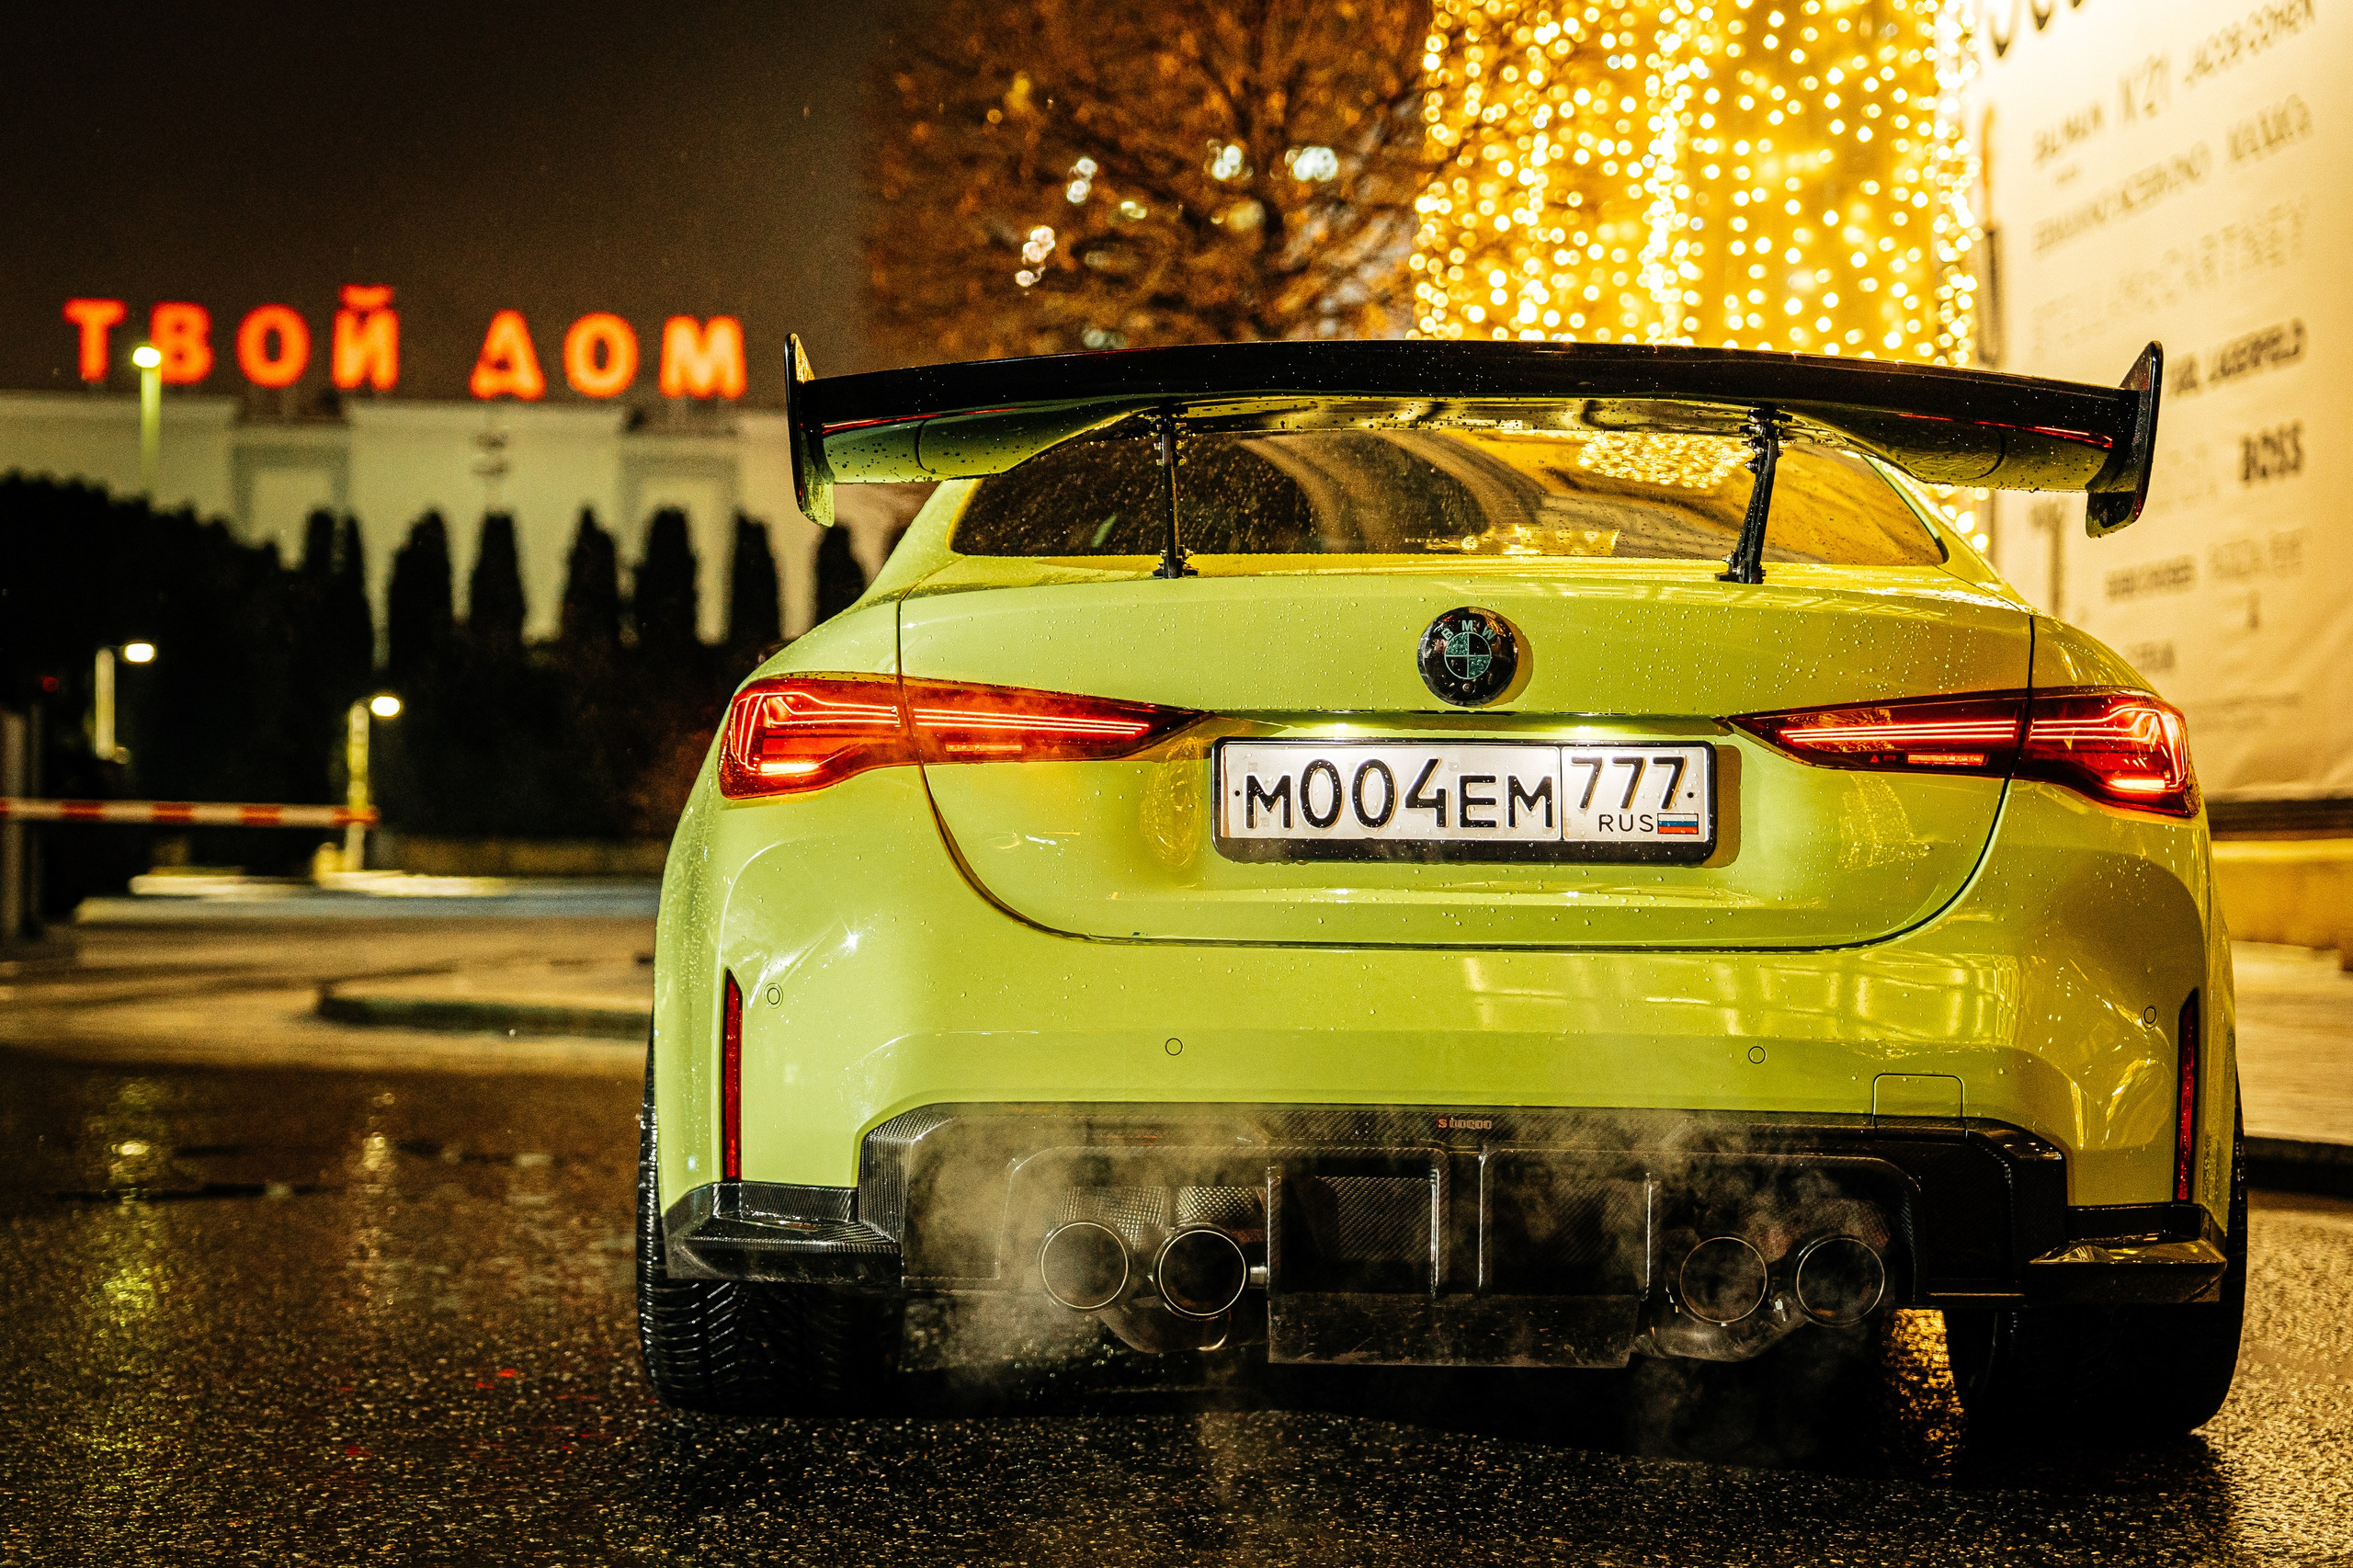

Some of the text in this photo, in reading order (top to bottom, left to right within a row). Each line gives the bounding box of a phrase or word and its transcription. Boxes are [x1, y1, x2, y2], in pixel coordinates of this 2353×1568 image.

[63, 283, 748, 402] ТВОЙ ДОМ
[2240, 419, 2305, 485] BOSS
[1440, 619, 1497, 641] BMW
[1571, 756, 1688, 811] 777
[1597, 813, 1654, 833] RUS
